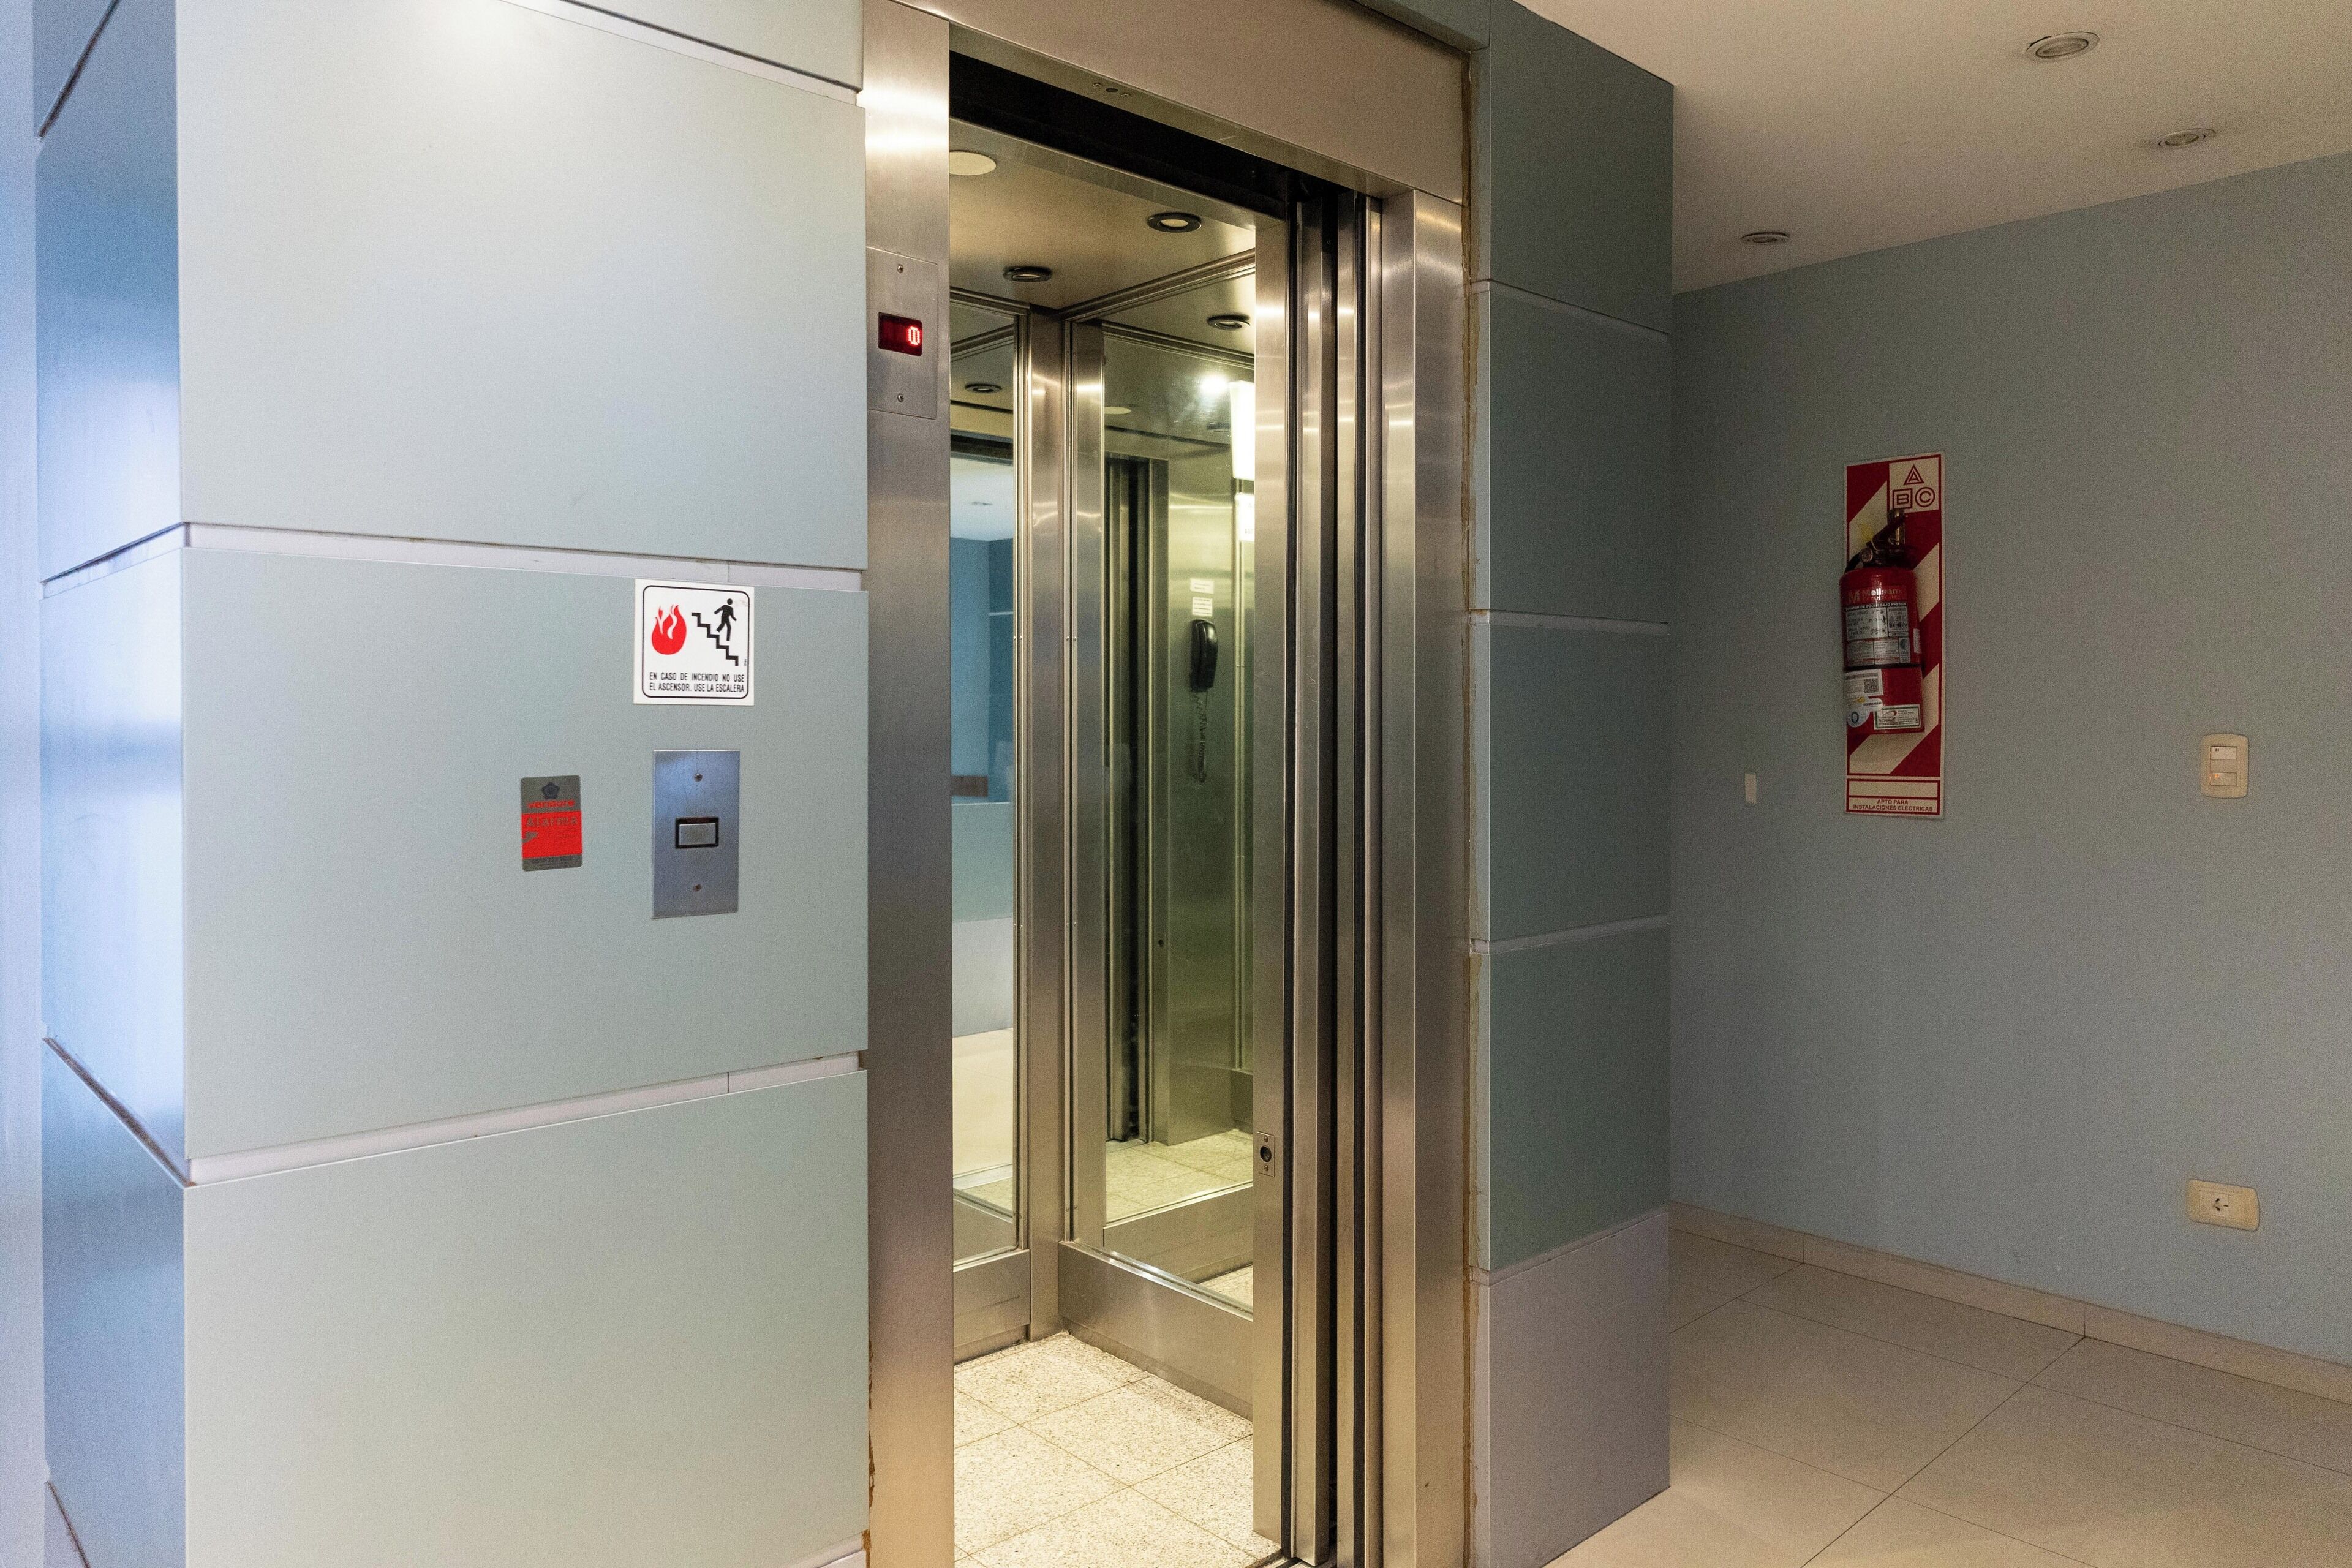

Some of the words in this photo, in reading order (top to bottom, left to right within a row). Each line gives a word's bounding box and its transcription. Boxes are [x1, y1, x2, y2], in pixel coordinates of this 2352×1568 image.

[1909, 471, 1920, 482] A
[1896, 494, 1909, 505] B
[1919, 491, 1932, 503] C
[661, 672, 676, 680] CASO
[692, 673, 718, 682] INCENDIO
[649, 682, 656, 691] EL
[526, 816, 578, 827] Alarma
